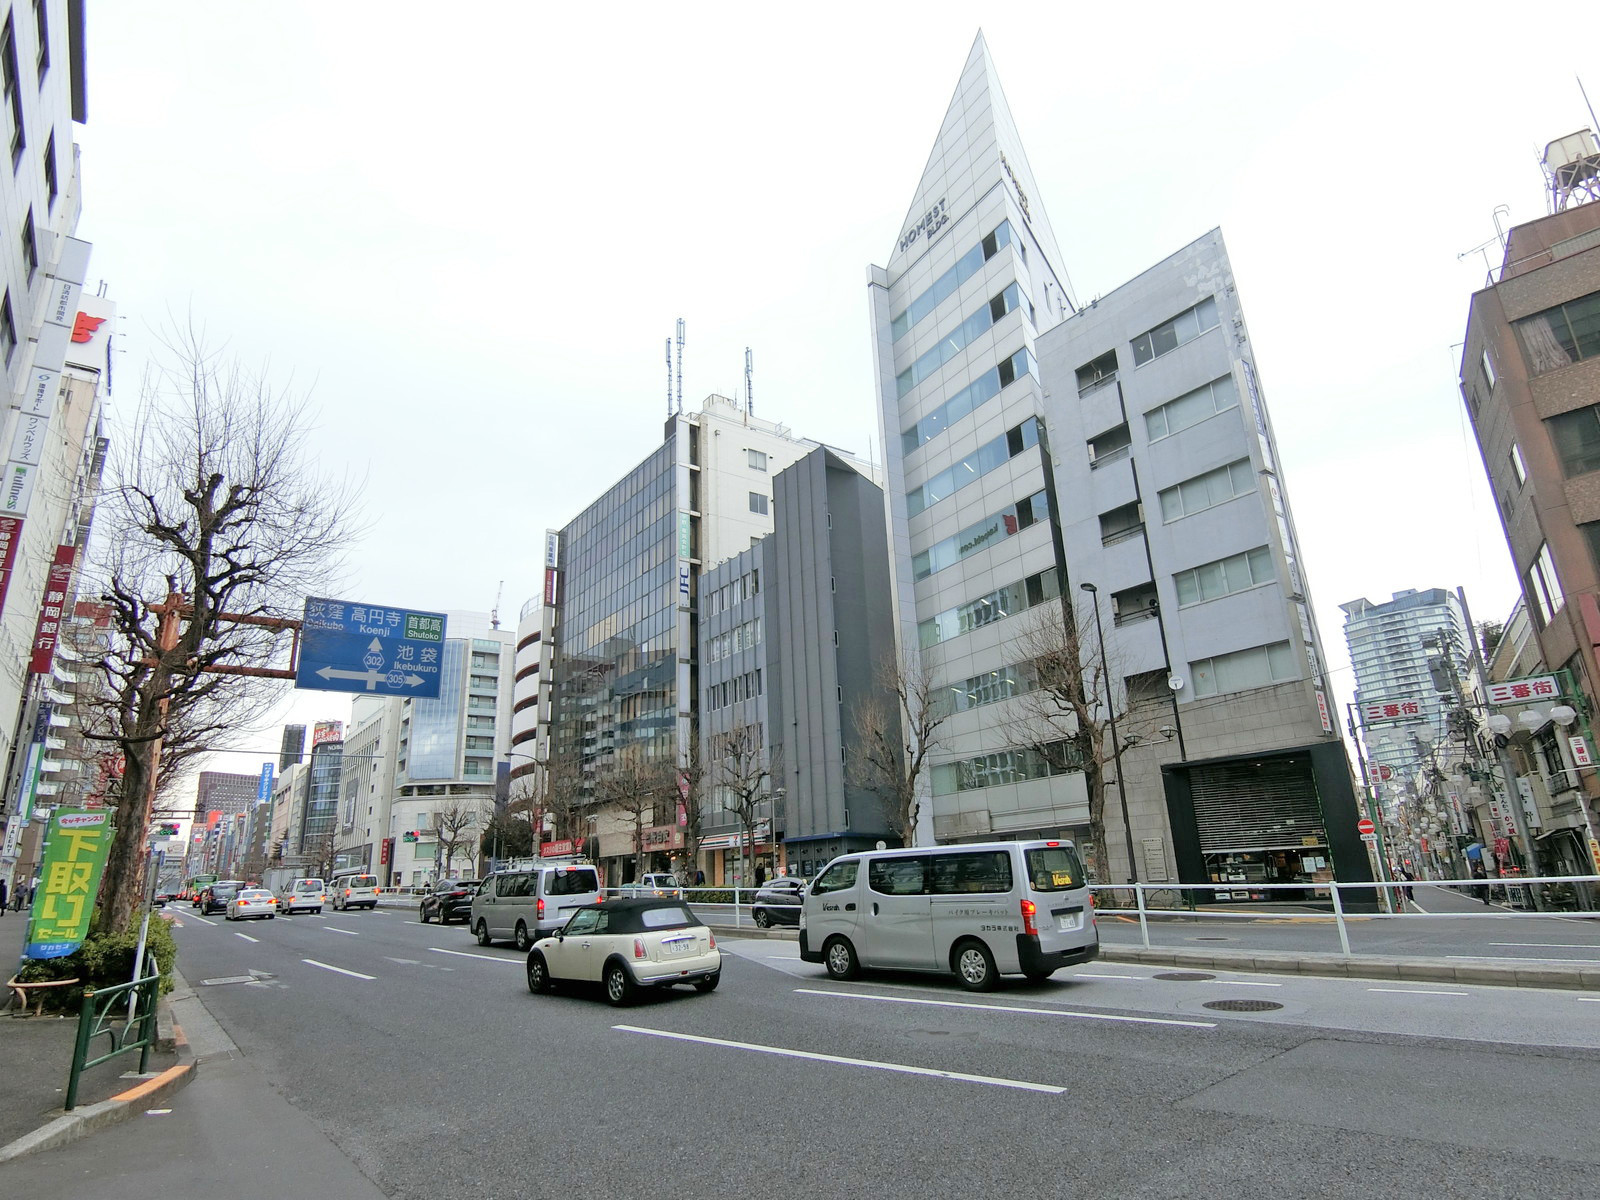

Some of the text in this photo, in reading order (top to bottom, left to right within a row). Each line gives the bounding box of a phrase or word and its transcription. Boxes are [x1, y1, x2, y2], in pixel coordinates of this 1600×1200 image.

[900, 198, 946, 252] HOMEST
[7, 466, 27, 510] Fullness
[679, 567, 689, 595] JFC
[38, 591, 64, 650] 静岡銀行
[309, 602, 402, 627] 荻窪 高円寺
[408, 616, 442, 632] 首都高
[359, 624, 391, 638] Koenji
[408, 630, 439, 641] Shutoko
[366, 656, 382, 666] 302
[396, 644, 439, 664] 池袋
[394, 661, 438, 673] Ikebukuro
[388, 674, 403, 684] 305
[1491, 681, 1553, 702] 三番街
[1366, 702, 1419, 719] 三番街
[1574, 739, 1588, 763] 三番街
[7, 824, 17, 853] TALENT
[42, 829, 101, 927] 下取り
[37, 928, 78, 939] セール
